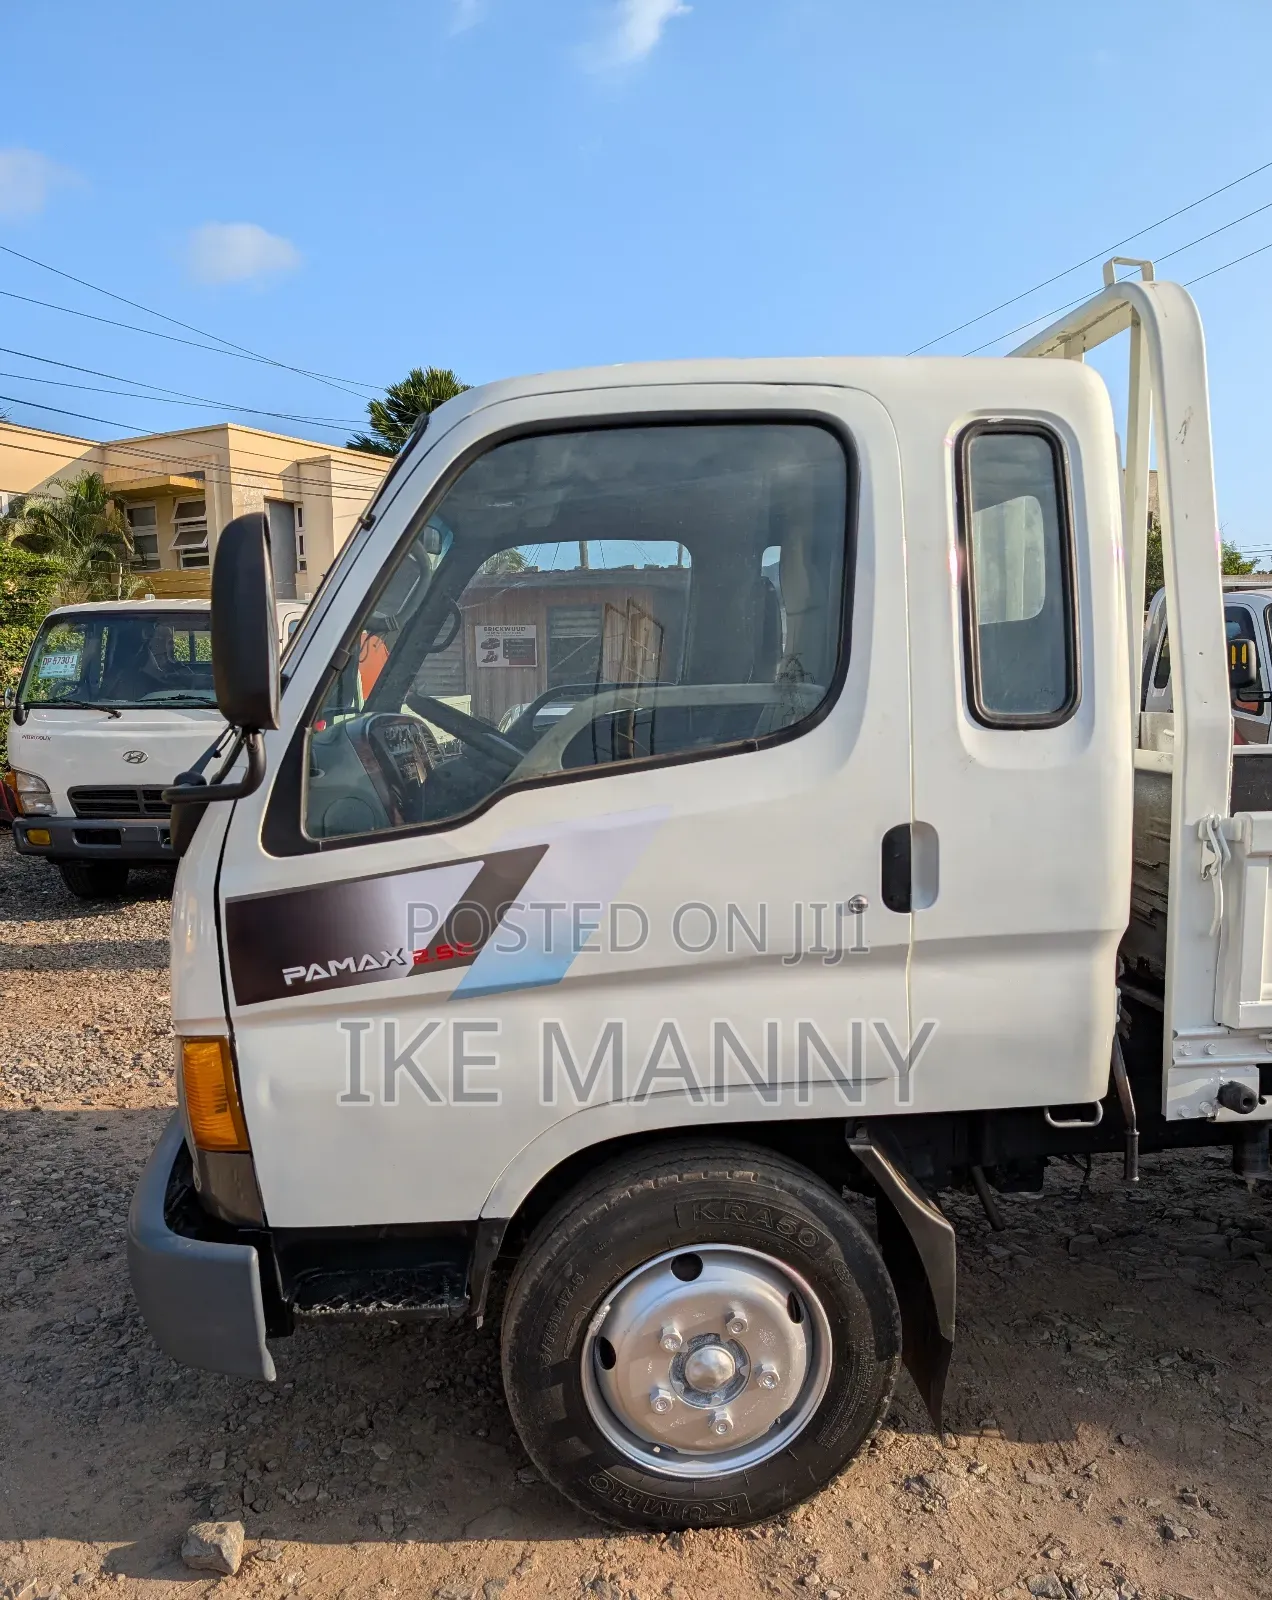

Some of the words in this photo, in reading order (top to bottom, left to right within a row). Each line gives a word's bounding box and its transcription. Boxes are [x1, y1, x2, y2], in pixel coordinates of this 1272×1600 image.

[282, 947, 407, 986] PAMAX
[693, 1201, 820, 1248] KRA50
[588, 1472, 740, 1521] KUMHO
